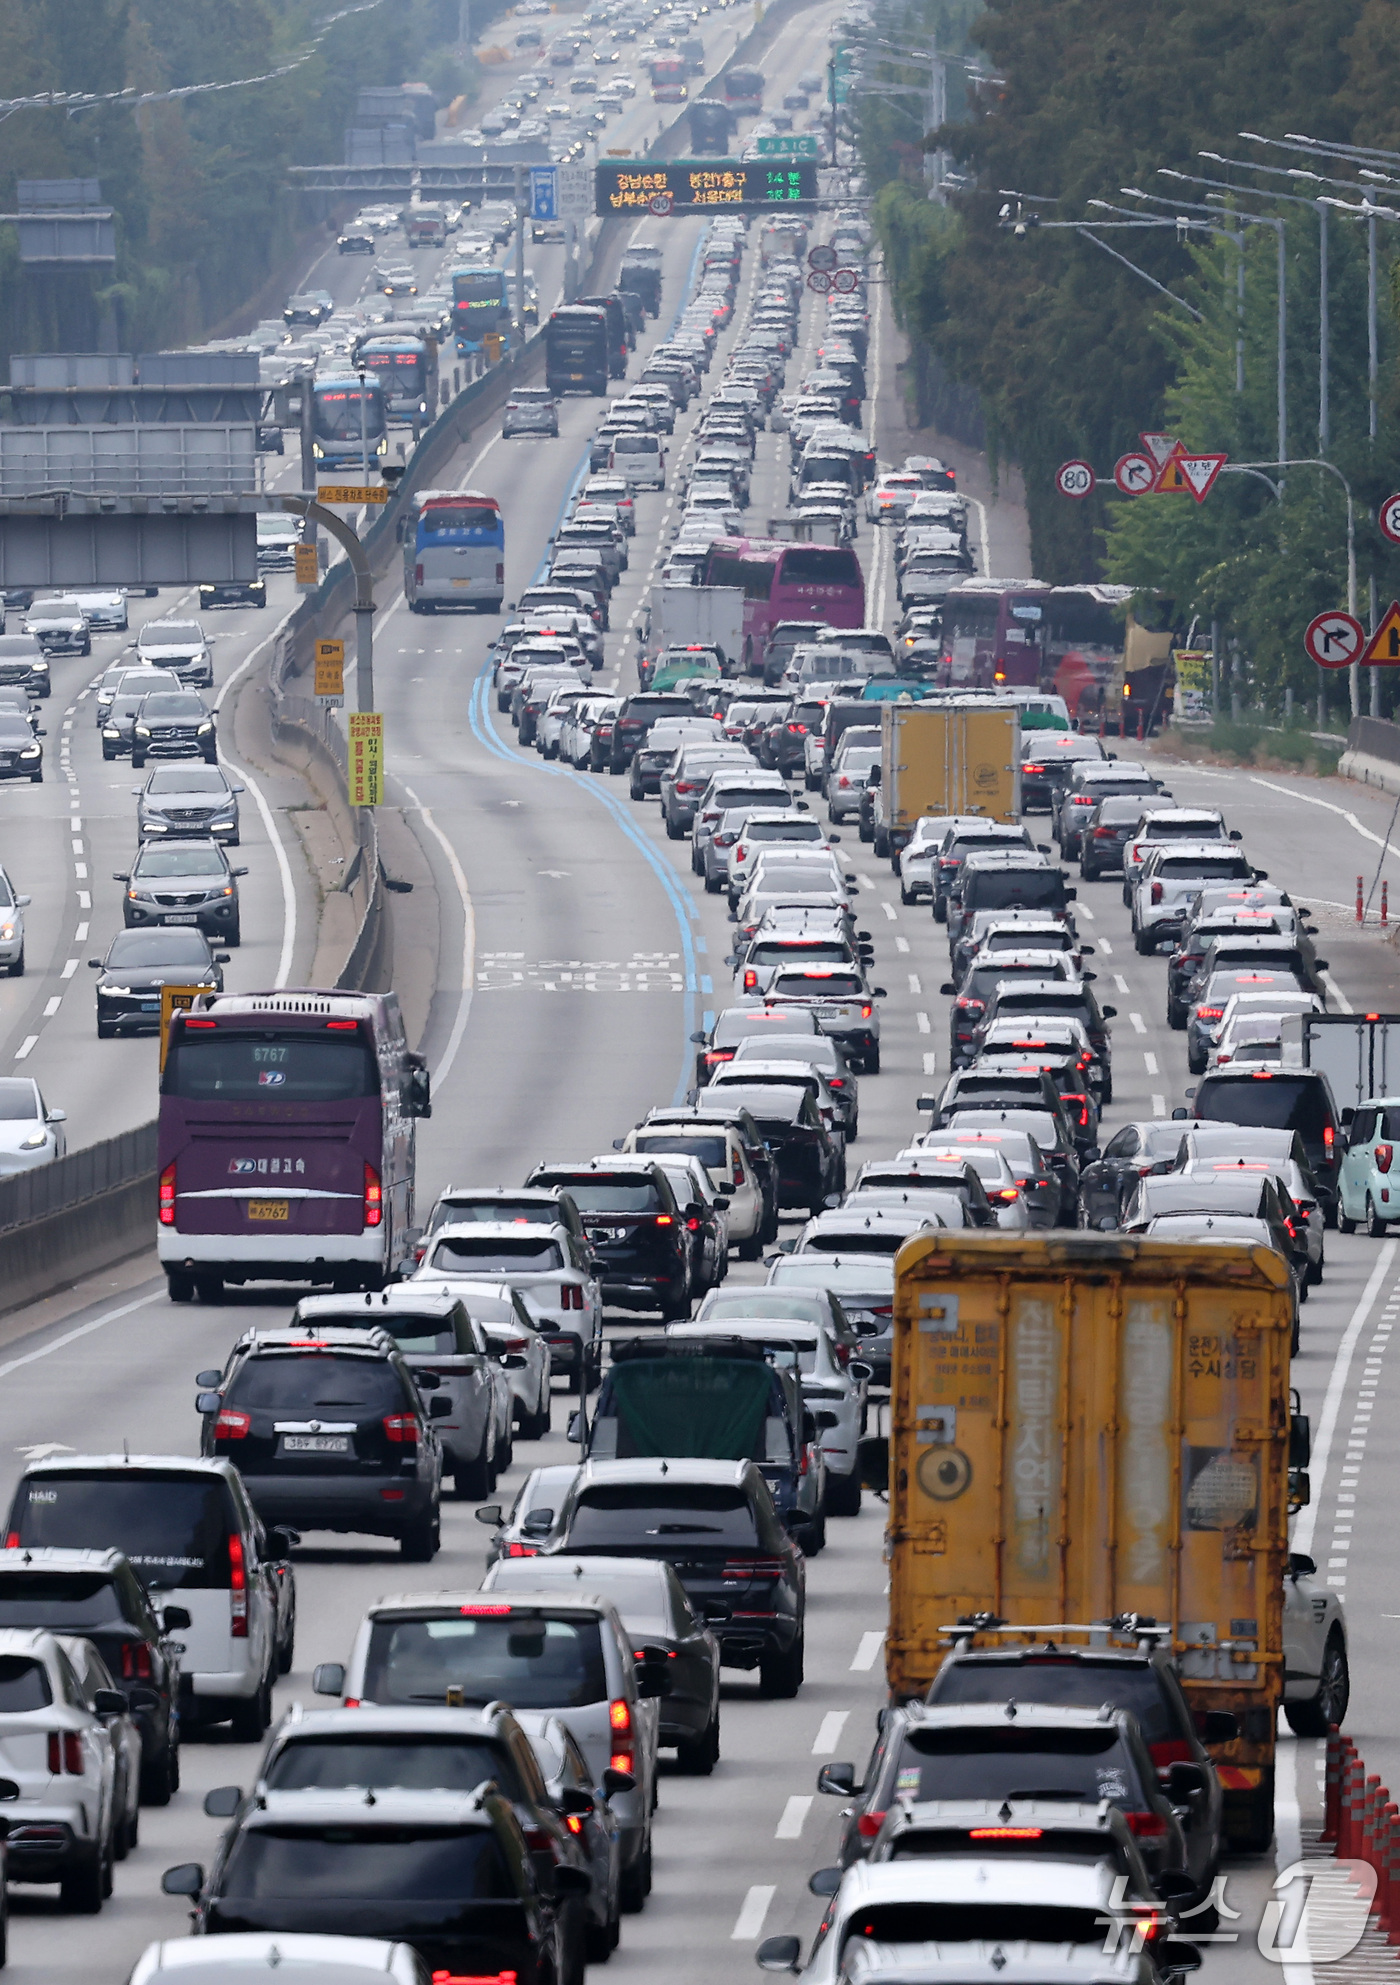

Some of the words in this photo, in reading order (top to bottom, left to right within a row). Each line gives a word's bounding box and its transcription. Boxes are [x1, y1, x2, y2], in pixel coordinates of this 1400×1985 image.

[1064, 470, 1088, 489] 80
[254, 1047, 286, 1062] 6767
[258, 1206, 287, 1219] 6767
